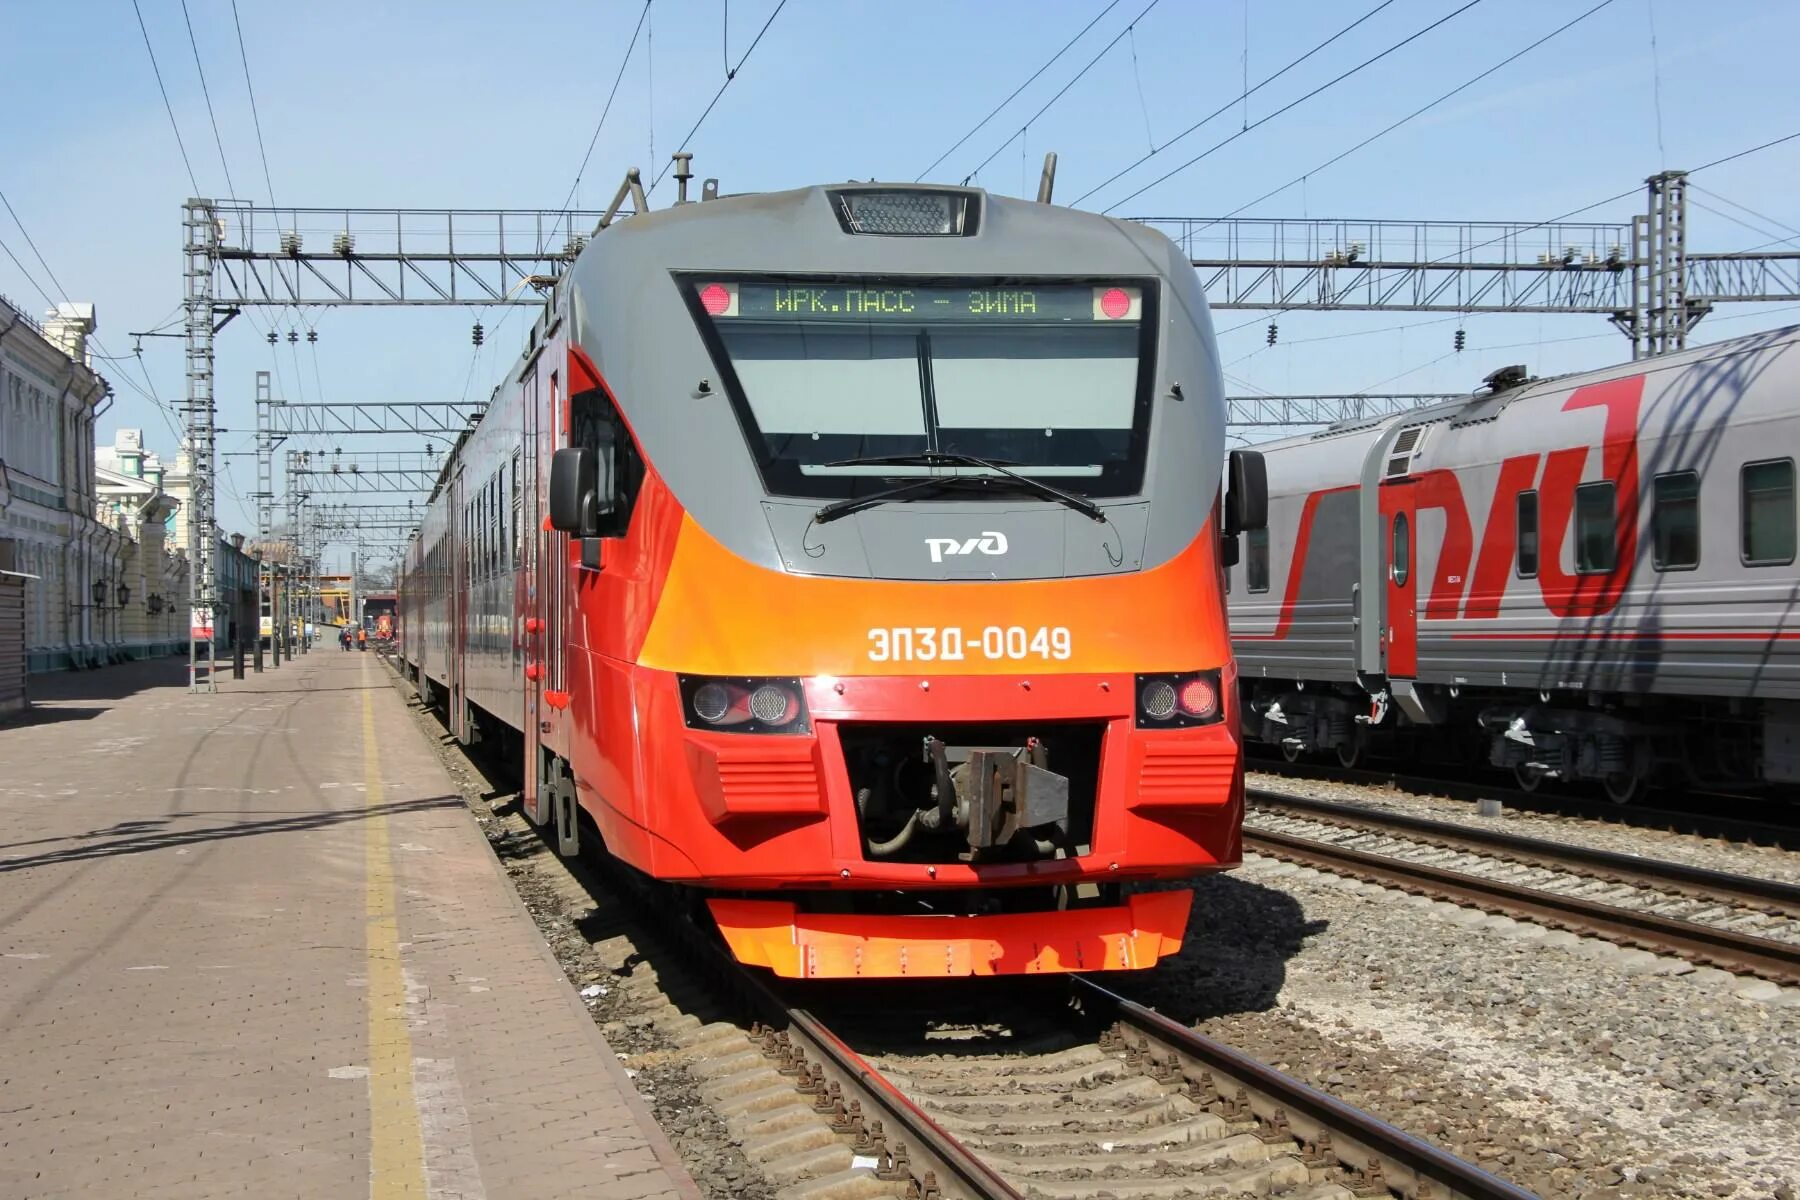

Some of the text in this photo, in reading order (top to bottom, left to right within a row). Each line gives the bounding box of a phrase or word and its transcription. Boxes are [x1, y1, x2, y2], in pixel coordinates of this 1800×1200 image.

[775, 289, 915, 313] ИРК.ПАСС
[968, 291, 1036, 314] ЗИМА
[924, 531, 1009, 563] РЖД
[867, 626, 1072, 662] ЭП3Д-0049
